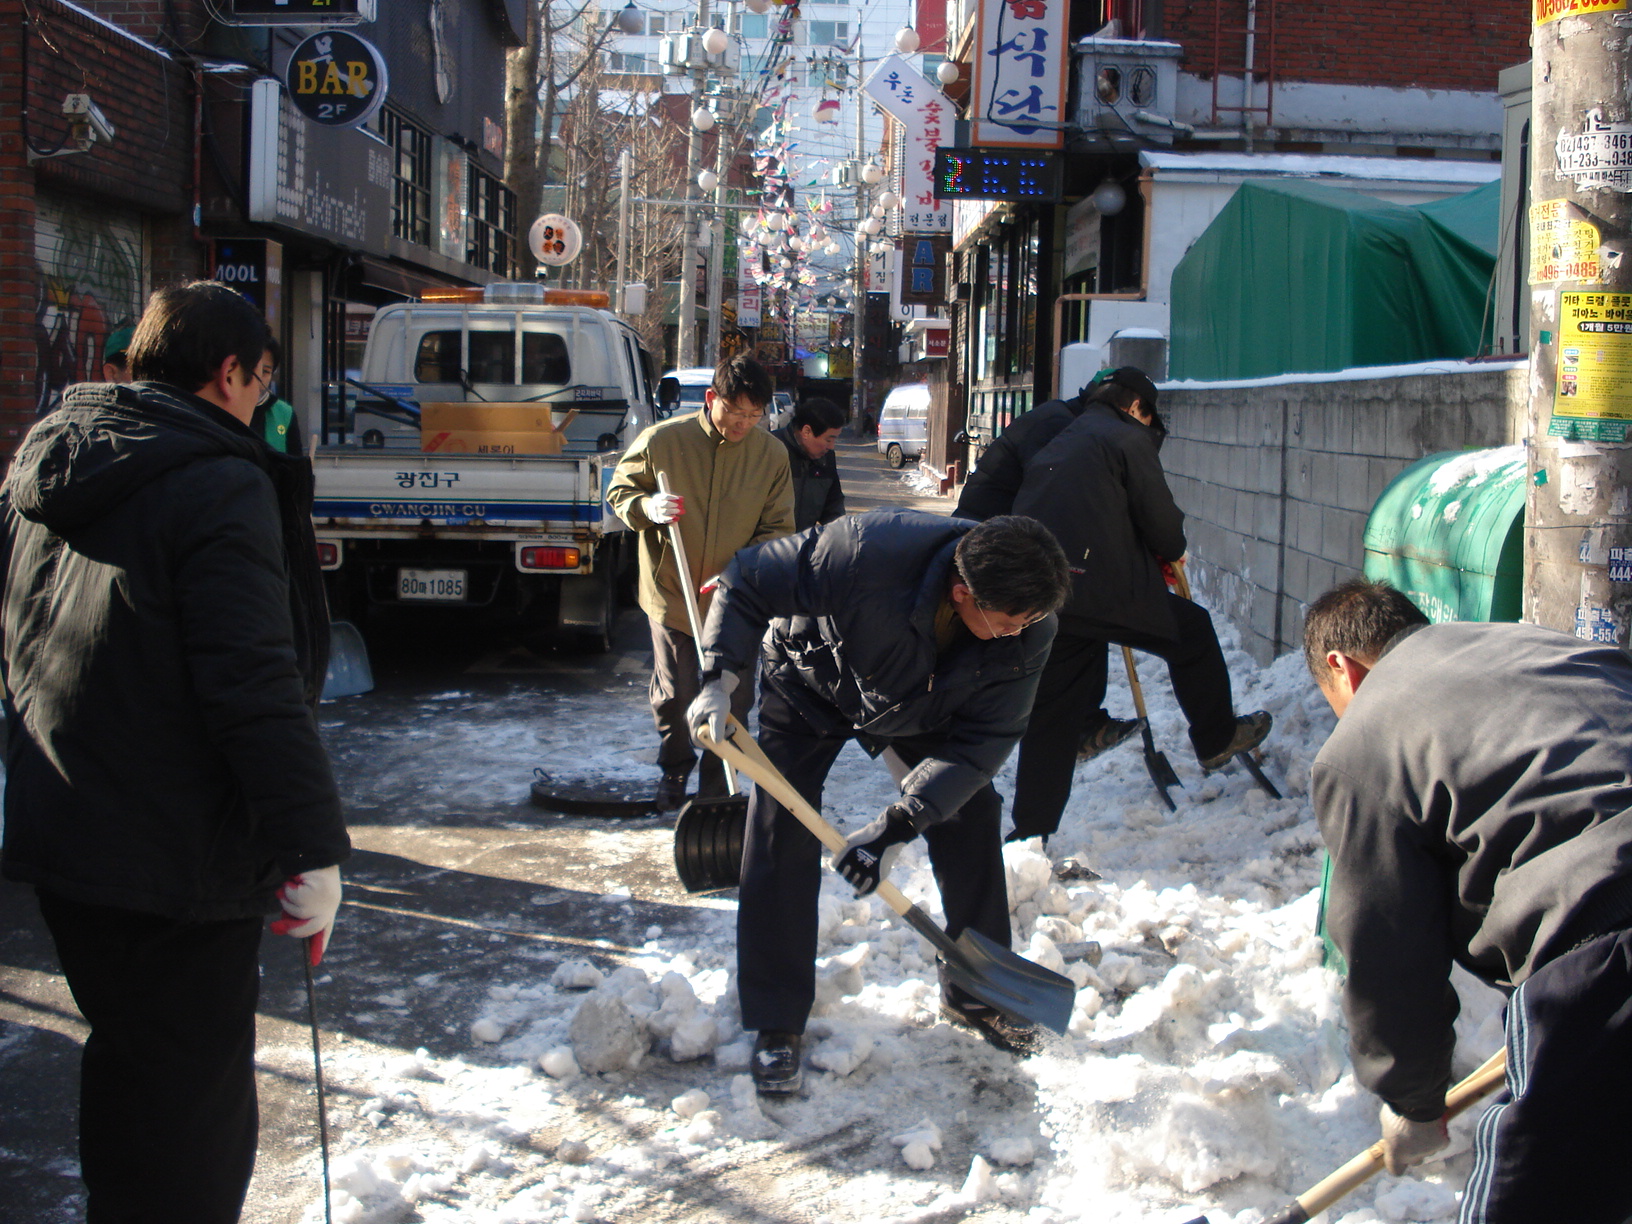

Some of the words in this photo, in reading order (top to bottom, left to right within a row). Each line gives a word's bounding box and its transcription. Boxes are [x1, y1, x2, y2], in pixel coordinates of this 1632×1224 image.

[297, 60, 370, 95] BAR
[318, 104, 347, 118] 2F
[1580, 322, 1604, 332] 1개월
[394, 471, 461, 489] 광진구
